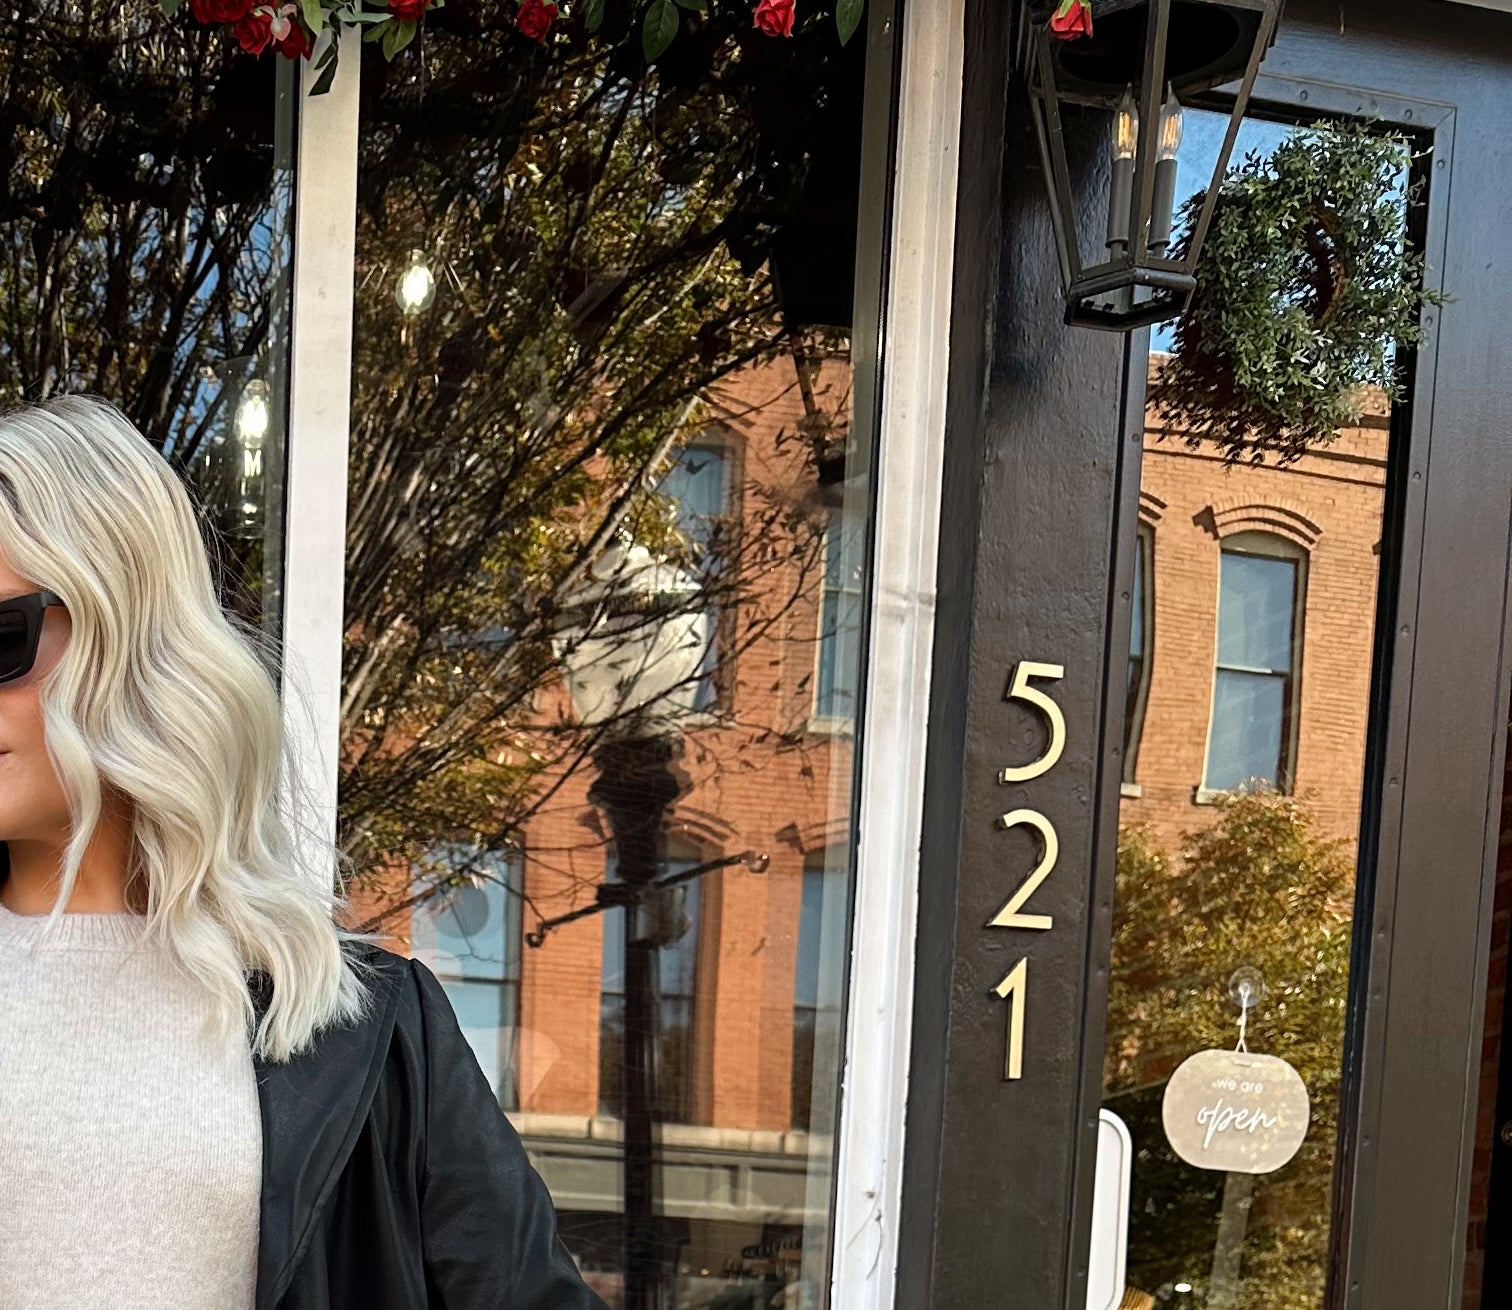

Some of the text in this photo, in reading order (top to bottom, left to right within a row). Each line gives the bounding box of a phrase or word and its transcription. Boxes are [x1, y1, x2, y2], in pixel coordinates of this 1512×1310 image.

[987, 660, 1066, 1081] 521
[1212, 1079, 1264, 1094] we are
[1196, 1097, 1277, 1150] open
